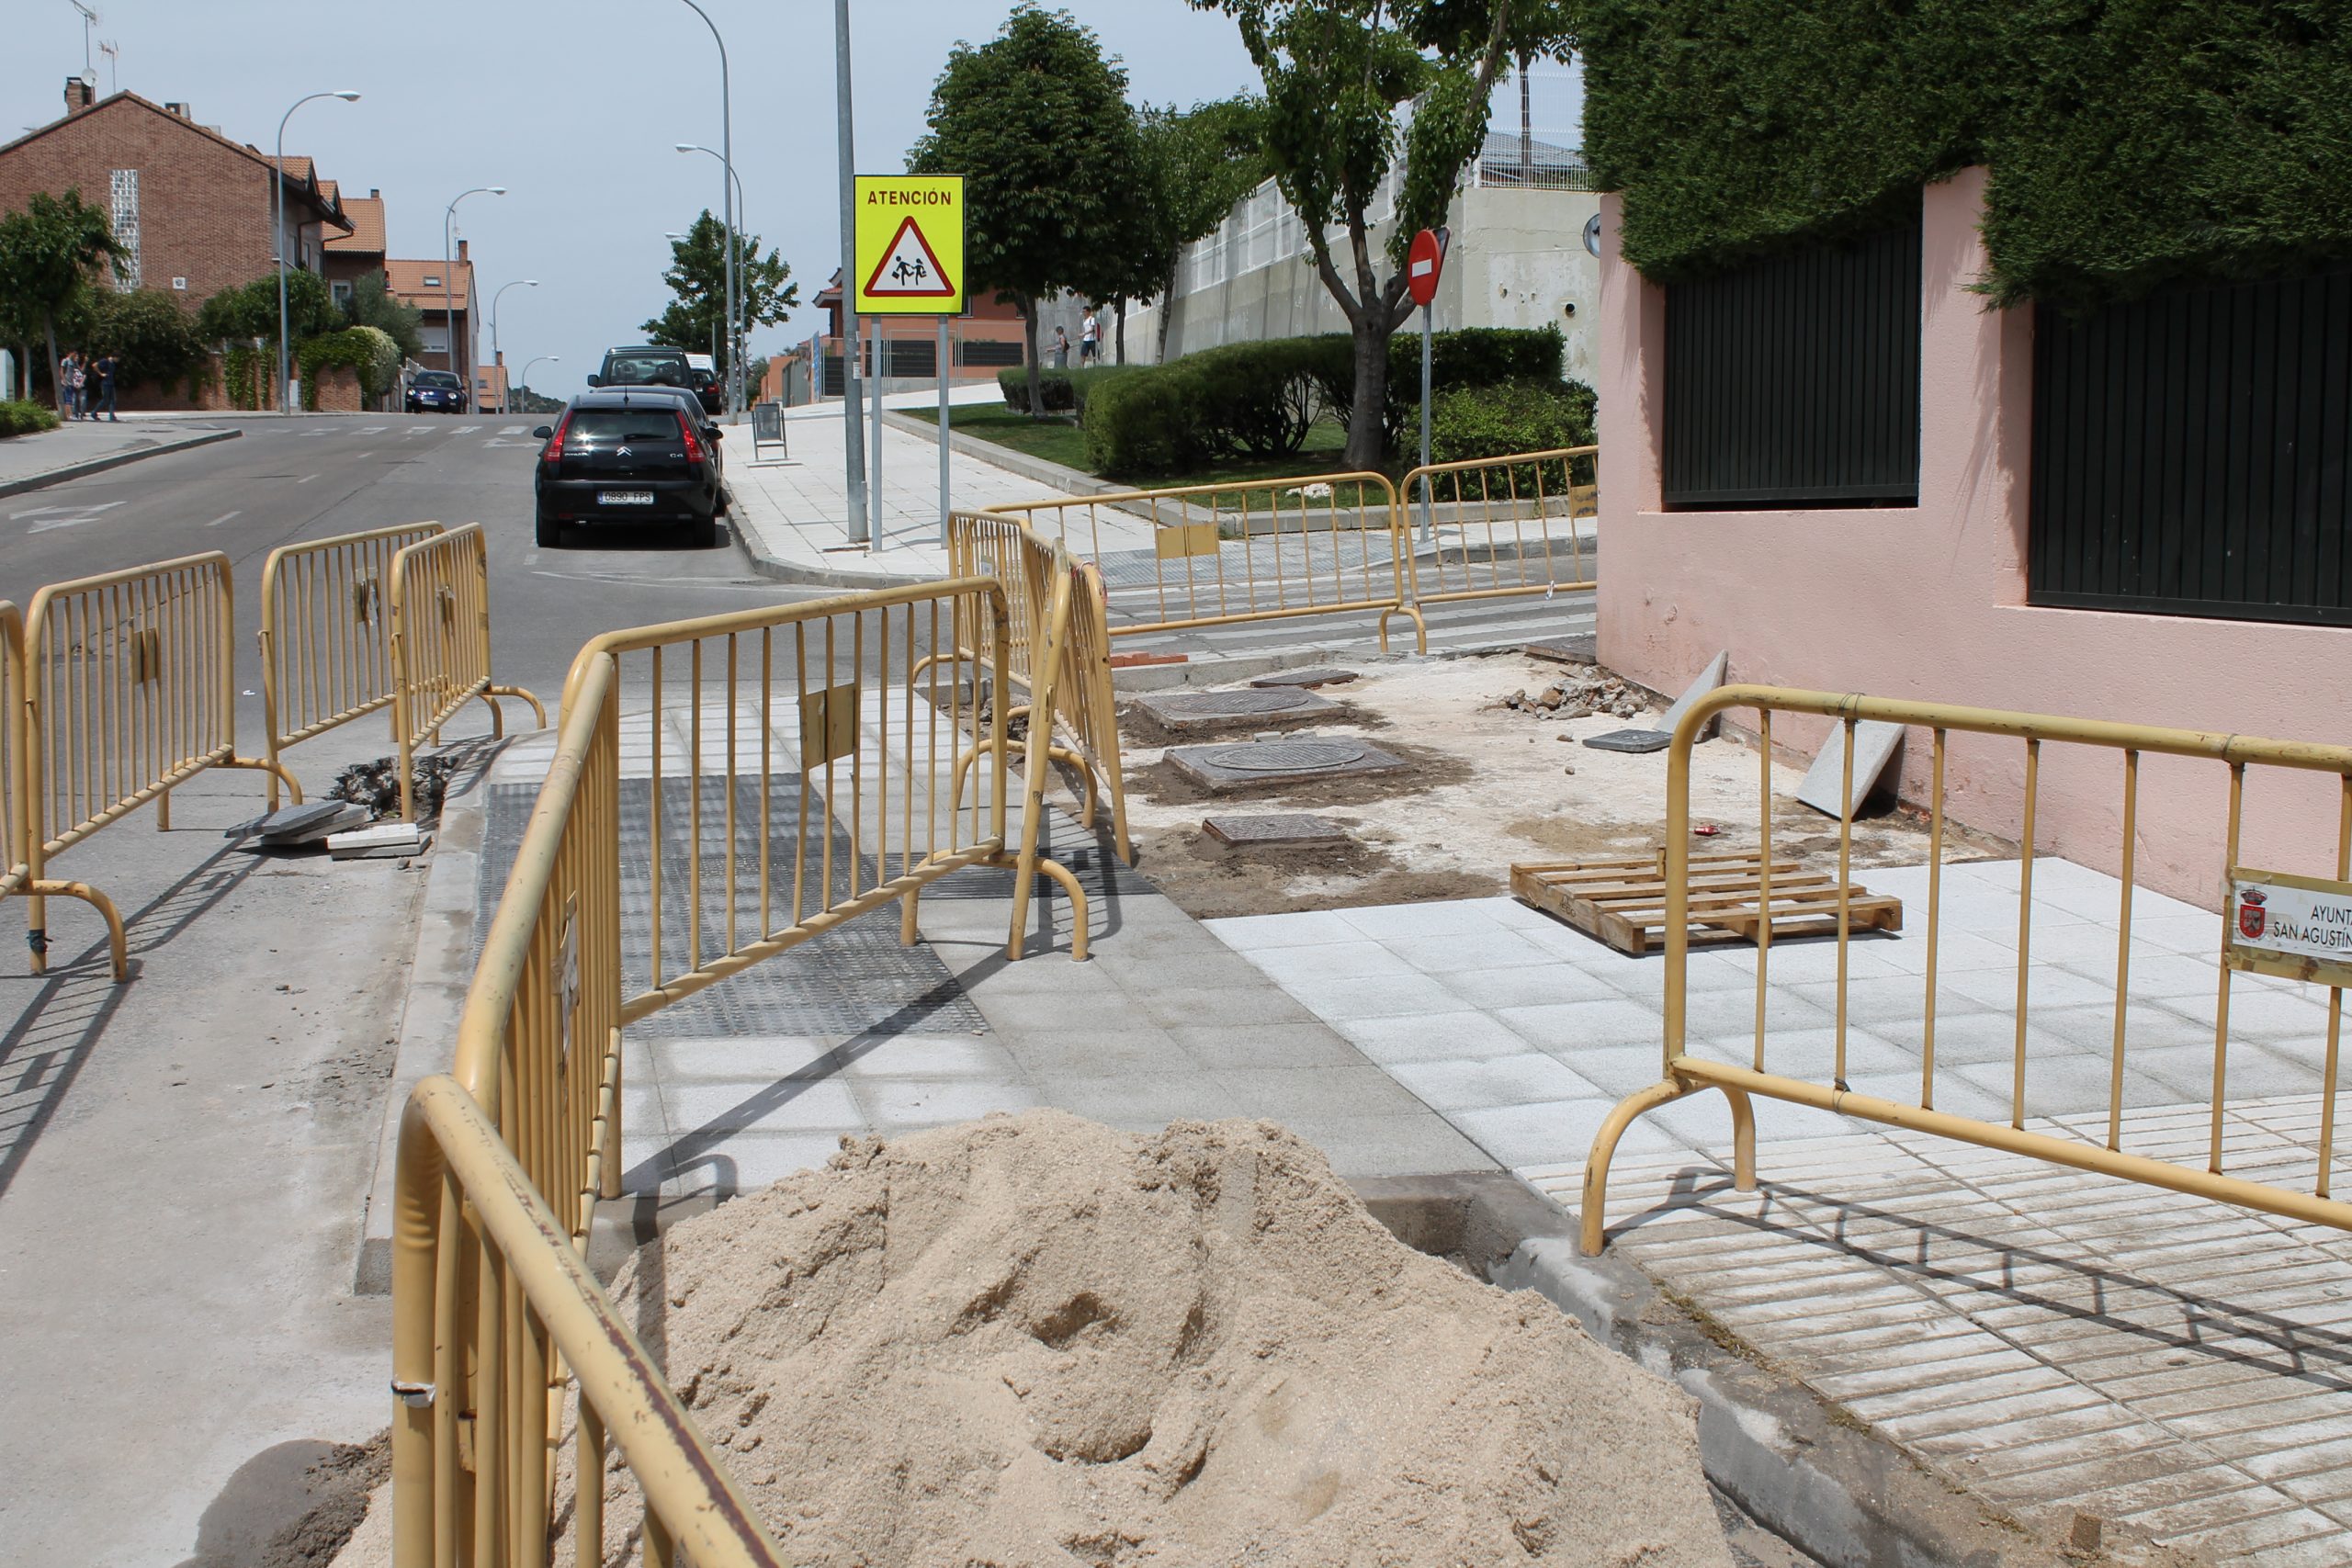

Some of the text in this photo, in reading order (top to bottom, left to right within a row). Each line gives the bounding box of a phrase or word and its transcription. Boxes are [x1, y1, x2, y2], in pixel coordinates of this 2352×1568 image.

[867, 187, 951, 205] ATENCIÓN
[605, 491, 651, 502] 0890 FPS
[2310, 904, 2352, 927] AYUNT
[2273, 920, 2299, 941] SAN
